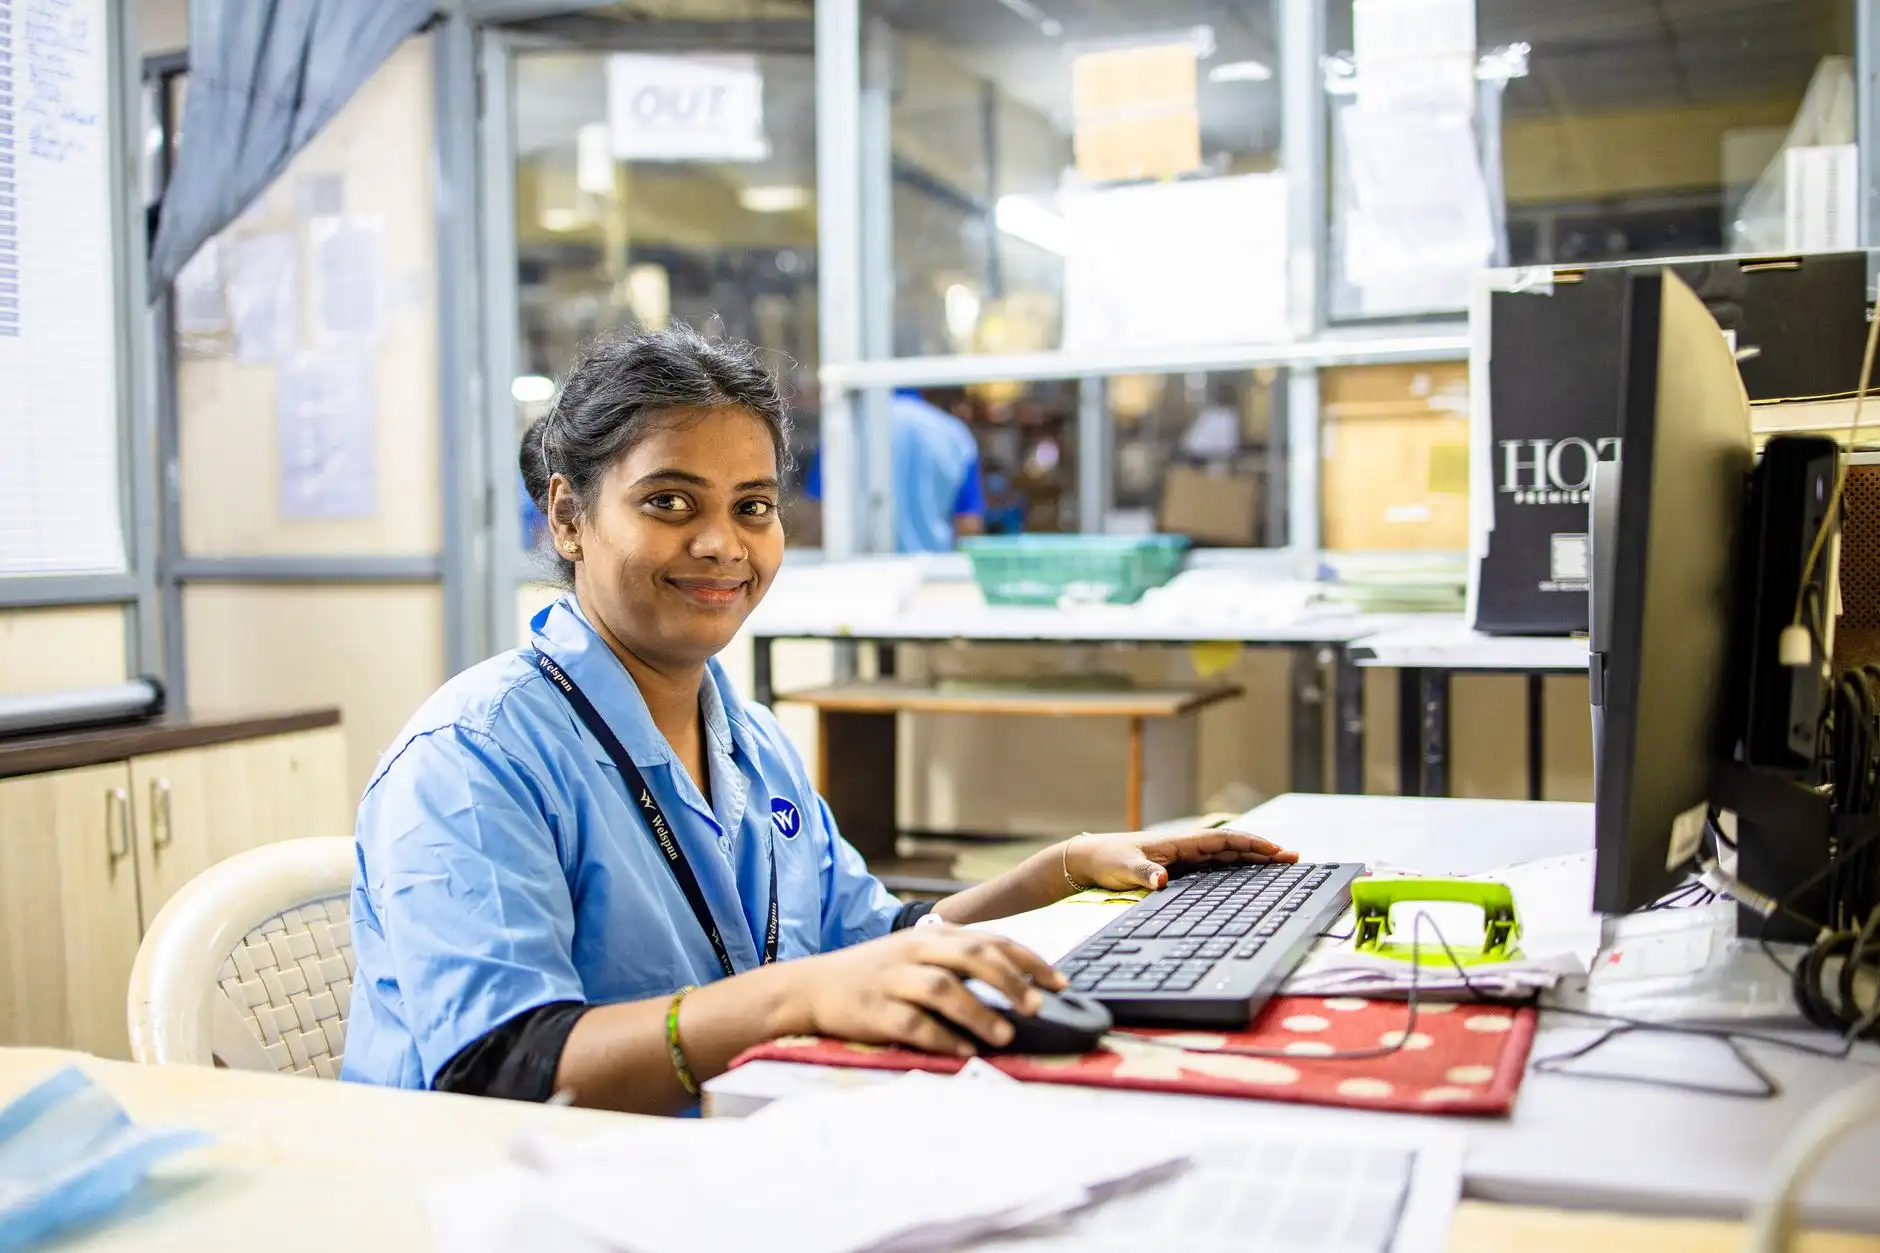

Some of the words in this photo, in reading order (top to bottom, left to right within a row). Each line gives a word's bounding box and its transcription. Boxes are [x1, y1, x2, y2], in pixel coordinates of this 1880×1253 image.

[629, 84, 731, 130] OUT
[540, 656, 572, 692] Welspun
[652, 814, 678, 860] Welspun
[767, 902, 778, 944] Welspun
